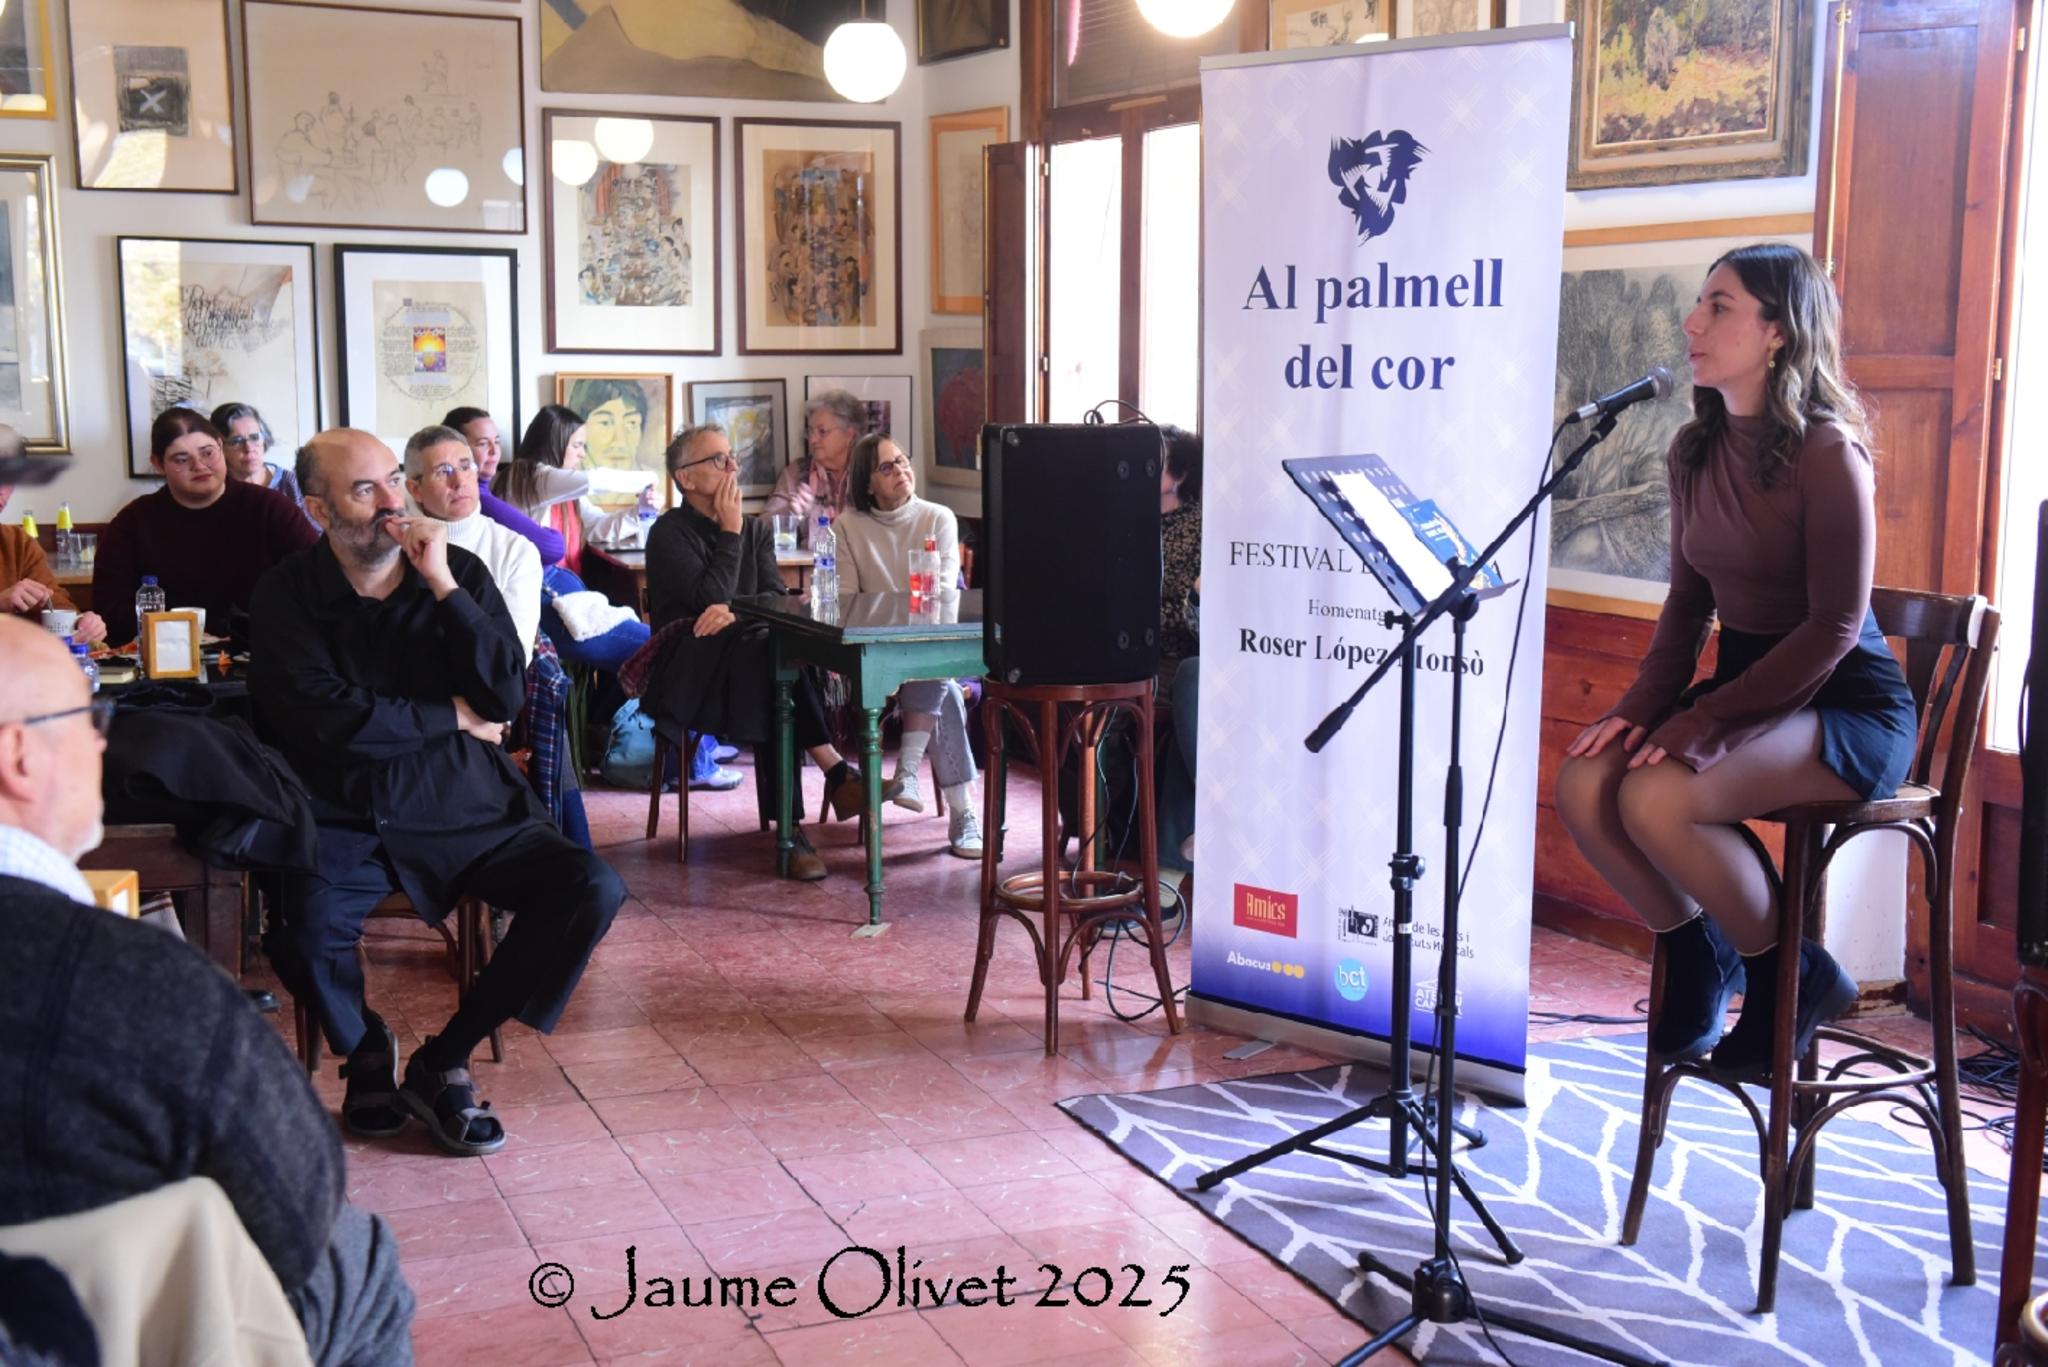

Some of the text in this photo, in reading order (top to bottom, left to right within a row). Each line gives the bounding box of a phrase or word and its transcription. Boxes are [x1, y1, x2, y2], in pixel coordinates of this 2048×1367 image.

[1242, 258, 1504, 324] Al palmell
[1285, 344, 1456, 390] del cor
[1230, 541, 1353, 573] FESTIVAL
[1240, 628, 1307, 658] Roser
[1246, 892, 1286, 920] Amics
[1226, 951, 1271, 971] Abacus
[1338, 965, 1366, 986] bct
